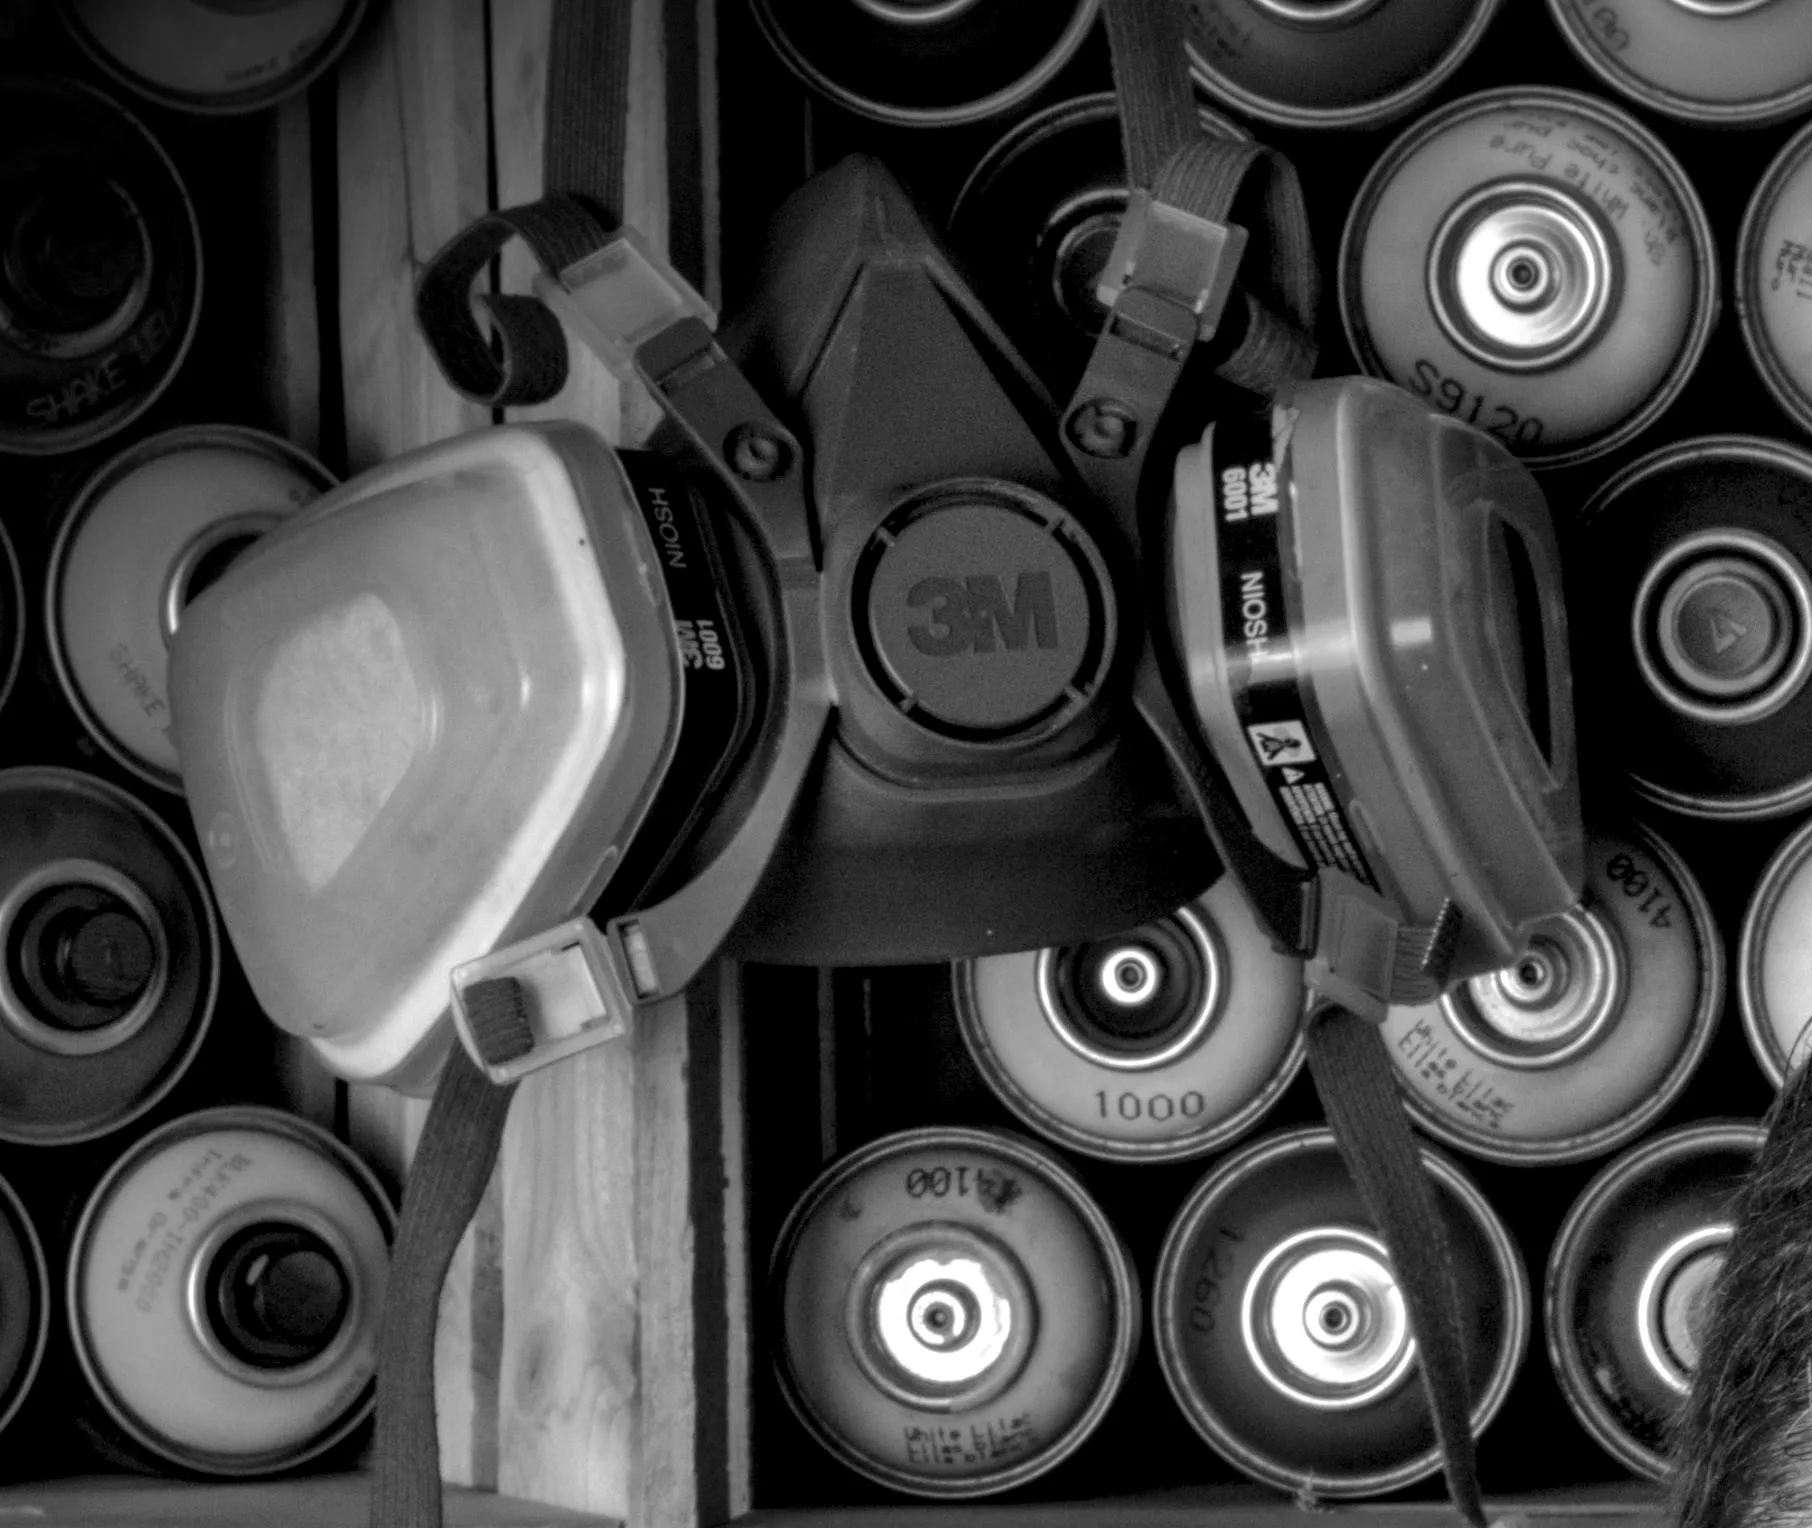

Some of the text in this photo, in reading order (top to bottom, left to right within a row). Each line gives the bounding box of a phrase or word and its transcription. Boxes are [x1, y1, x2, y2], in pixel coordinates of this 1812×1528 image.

[26, 354, 127, 422] SHAKE
[1408, 360, 1542, 442] S9120
[1222, 466, 1249, 522] 6001
[1249, 462, 1279, 516] 3M
[648, 487, 688, 569] NIOSH
[696, 619, 726, 671] 6001
[907, 571, 1060, 657] 3M
[1240, 571, 1269, 664] NIOSH
[1606, 853, 1673, 928] 4100
[1094, 1089, 1205, 1121] 1000
[1188, 1227, 1240, 1333] 1260
